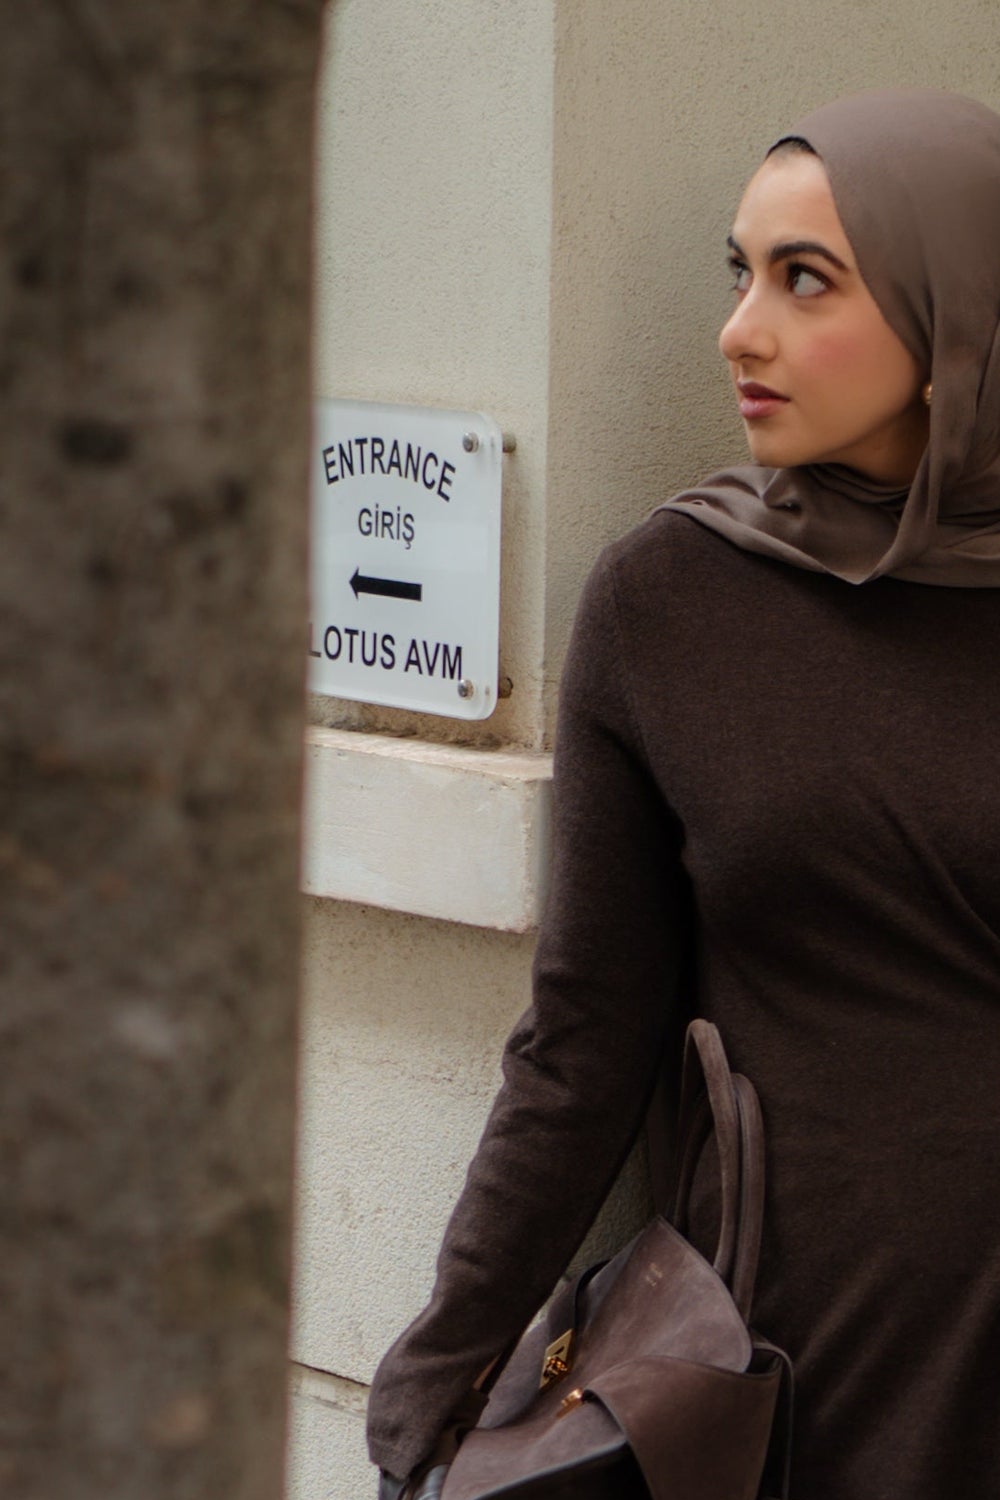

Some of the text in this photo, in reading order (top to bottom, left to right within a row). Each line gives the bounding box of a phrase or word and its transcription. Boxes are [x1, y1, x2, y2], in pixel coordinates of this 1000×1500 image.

[322, 437, 456, 502] ENTRANCE
[358, 504, 415, 549] GİRİŞ
[404, 639, 462, 680] AVM
